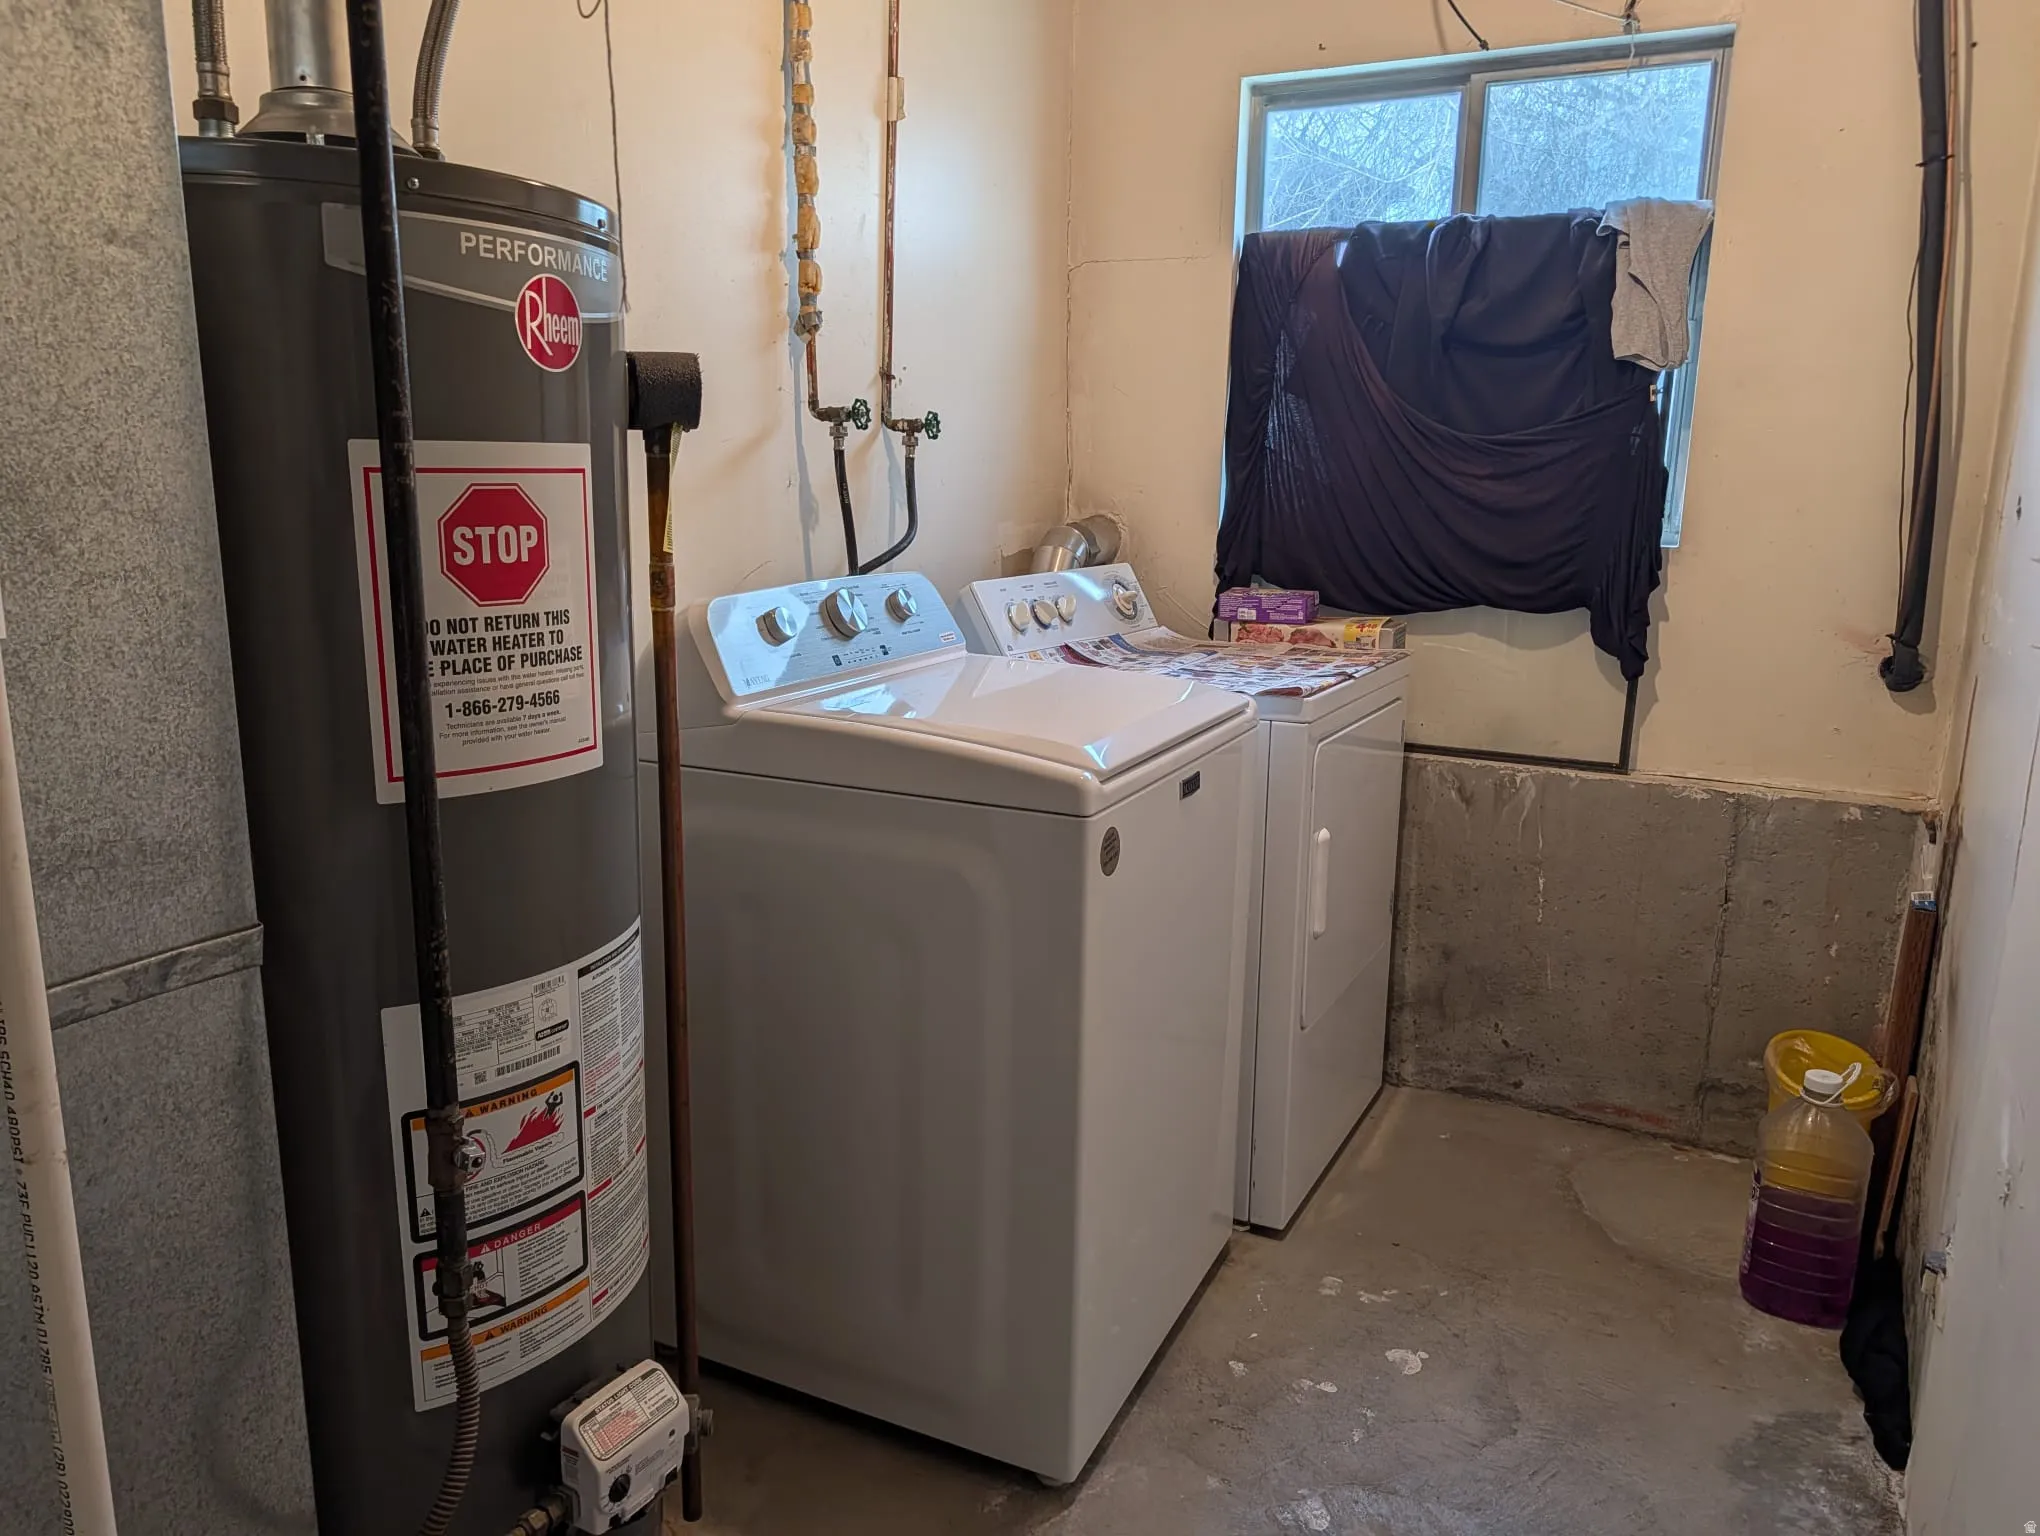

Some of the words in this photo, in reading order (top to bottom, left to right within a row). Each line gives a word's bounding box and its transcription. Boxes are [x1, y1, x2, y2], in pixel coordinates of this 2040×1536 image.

[460, 231, 609, 283] PERFORMANCE
[524, 277, 579, 356] Rheem
[453, 525, 538, 564] STOP
[448, 617, 478, 634] NOT
[484, 612, 540, 632] RETURN
[544, 609, 570, 626] THIS
[430, 637, 487, 656] WATER
[493, 632, 545, 651] HEATER
[549, 629, 564, 645] TO
[440, 657, 491, 676] PLACE
[497, 655, 515, 671] OF
[520, 646, 583, 668] PURCHASE
[434, 679, 475, 688] experiencing
[445, 690, 560, 719] 1-866-279-4566
[447, 721, 483, 730] Technicians
[496, 716, 522, 725] available
[527, 712, 541, 721] days
[462, 736, 489, 747] provided
[504, 733, 517, 741] your
[518, 730, 532, 738] water
[0, 1050, 16, 1101] SCH40
[480, 1088, 538, 1115] WARNING
[7, 1105, 24, 1164] 480PSI
[503, 1149, 534, 1164] Flammable
[17, 1181, 30, 1210] 73F
[494, 1222, 541, 1249] DANGER
[31, 1284, 46, 1325] ASTM
[500, 1307, 548, 1335] WARNING
[594, 1397, 615, 1415] STATUS
[613, 1386, 630, 1400] LIGHT
